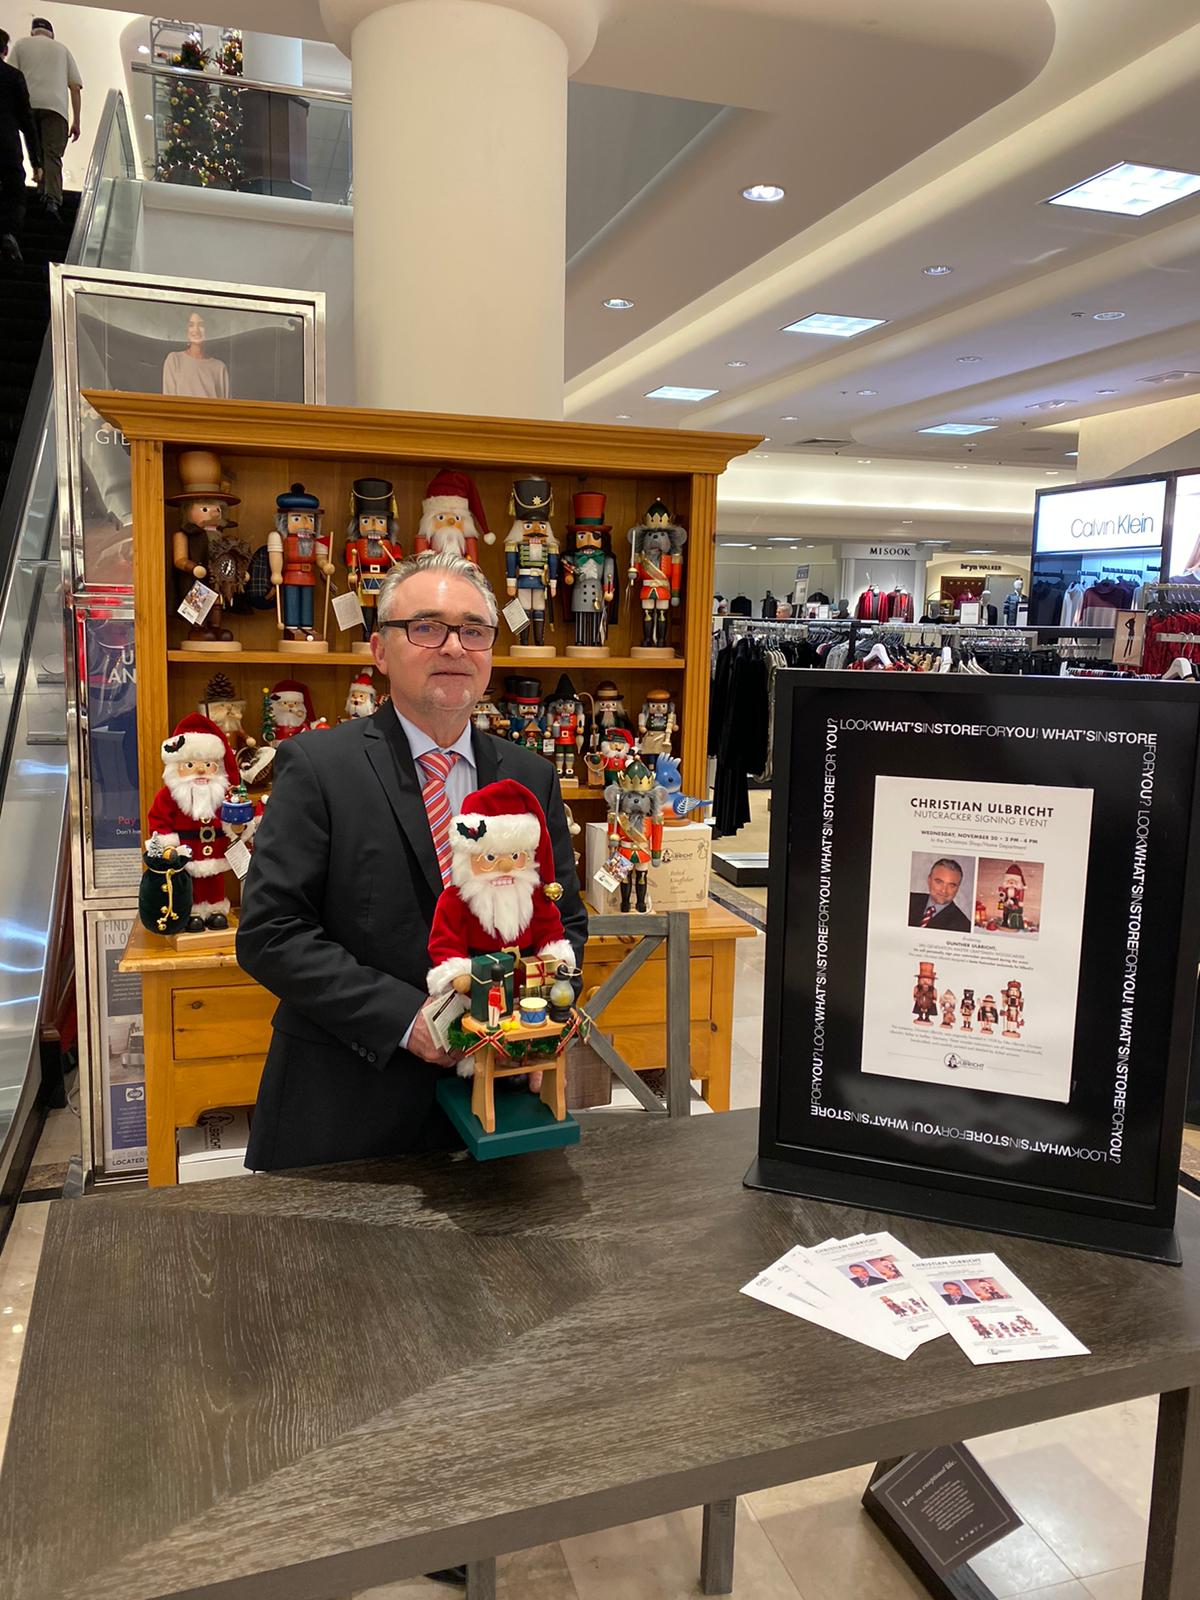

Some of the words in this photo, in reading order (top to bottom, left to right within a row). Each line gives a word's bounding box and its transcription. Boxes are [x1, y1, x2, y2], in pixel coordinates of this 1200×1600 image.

[1070, 518, 1115, 538] Calvin
[1118, 512, 1154, 534] Klein
[869, 547, 911, 556] MISOOK
[910, 798, 981, 811] CHRISTIAN
[987, 803, 1053, 817] ULBRICHT
[914, 810, 971, 822] NUTCRACKER
[974, 814, 1016, 825] SIGNING
[1019, 818, 1048, 828] EVENT
[103, 920, 129, 932] FIND
[104, 933, 116, 945] IN
[112, 1157, 145, 1167] LOCATED
